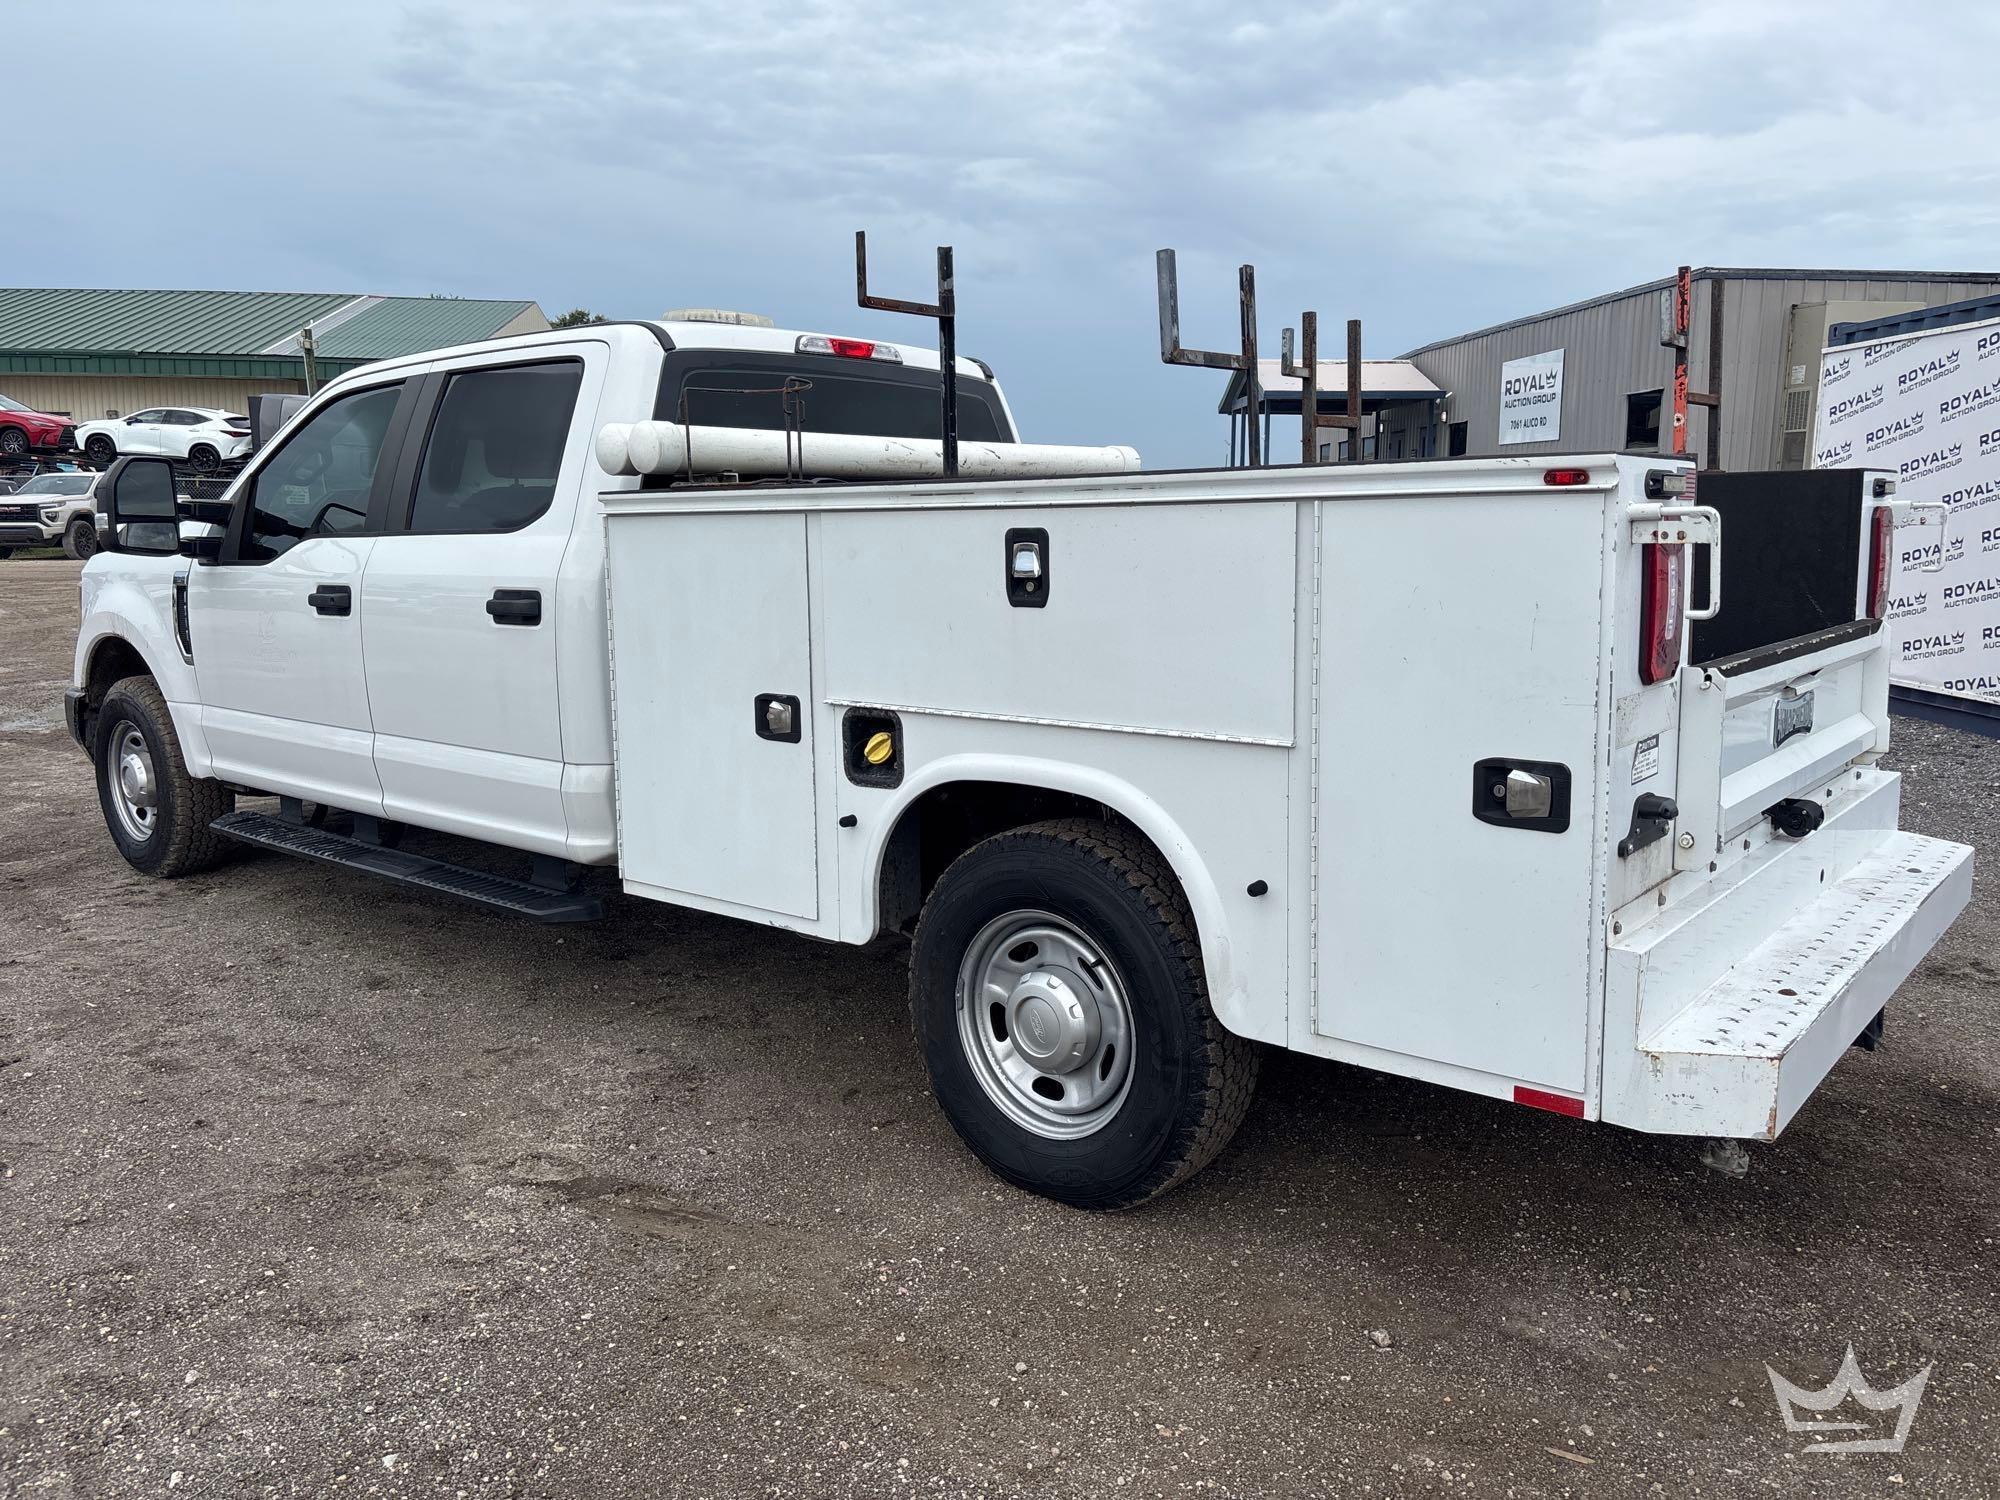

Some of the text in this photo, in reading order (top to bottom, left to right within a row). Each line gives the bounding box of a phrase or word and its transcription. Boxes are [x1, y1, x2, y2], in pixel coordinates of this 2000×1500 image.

[1865, 348, 1895, 368] AUCTION
[1828, 371, 1851, 386] GROUP
[1898, 358, 1946, 387] ROYAL
[1899, 364, 1960, 396] AUCTION GROUP
[1505, 374, 1545, 396] ROYAL
[1504, 392, 1556, 408] AUCTION GROUP
[1829, 392, 1871, 417] ROYAL
[1940, 386, 1991, 414] ROYAL
[1830, 397, 1883, 426] AUCTION GROUP
[1940, 405, 1976, 424] AUCTION
[1523, 418, 1538, 429] ALICO
[1540, 417, 1547, 427] RD
[1866, 418, 1910, 444] ROYAL
[1867, 425, 1924, 452] AUCTION GROUP
[1829, 454, 1852, 467] GROUP
[1900, 450, 1948, 475] ROYAL
[1901, 457, 1962, 484] AUCTION GROUP
[1942, 482, 1993, 505] ROYAL
[1902, 544, 1950, 563] ROYA
[1902, 558, 1935, 572] AUCTION
[1943, 578, 1995, 599] ROYAL
[1901, 606, 1927, 618] GROUP
[1944, 595, 1979, 609] AUCTION
[1903, 635, 1951, 652] ROYAL
[1903, 646, 1965, 661] AUCTION GROUP
